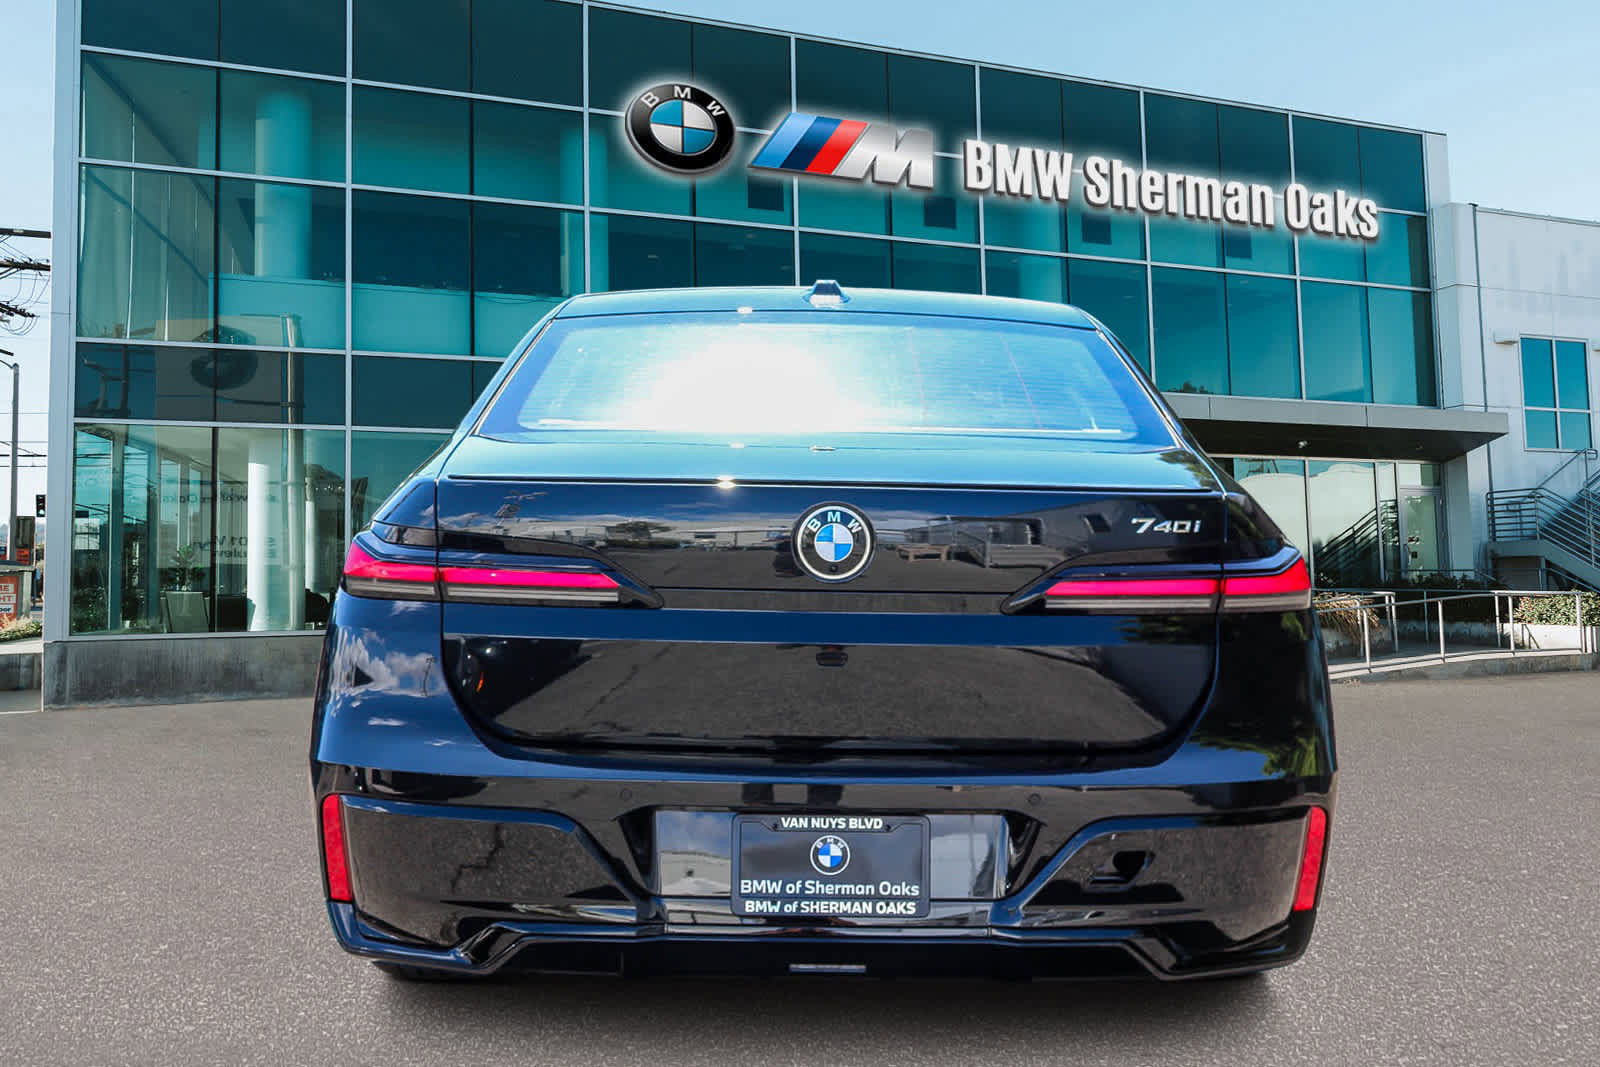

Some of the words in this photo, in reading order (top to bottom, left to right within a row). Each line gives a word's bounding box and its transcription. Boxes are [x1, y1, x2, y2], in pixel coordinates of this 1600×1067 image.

[641, 85, 726, 118] BMW
[963, 138, 1073, 201] BMW
[1083, 156, 1275, 226] Sherman
[1284, 183, 1380, 240] Oaks
[807, 511, 862, 534] BMW
[1131, 517, 1202, 534] 740i
[780, 816, 808, 829] VAN
[811, 817, 847, 829] NUYS
[849, 817, 884, 830] BLVD
[740, 879, 783, 894] BMW
[785, 879, 802, 895] of
[804, 880, 875, 896] Sherman
[879, 881, 920, 896] Oaks
[744, 900, 783, 913] BMW
[784, 900, 799, 913] of
[801, 901, 873, 914] SHERMAN
[876, 901, 916, 915] OAKS
